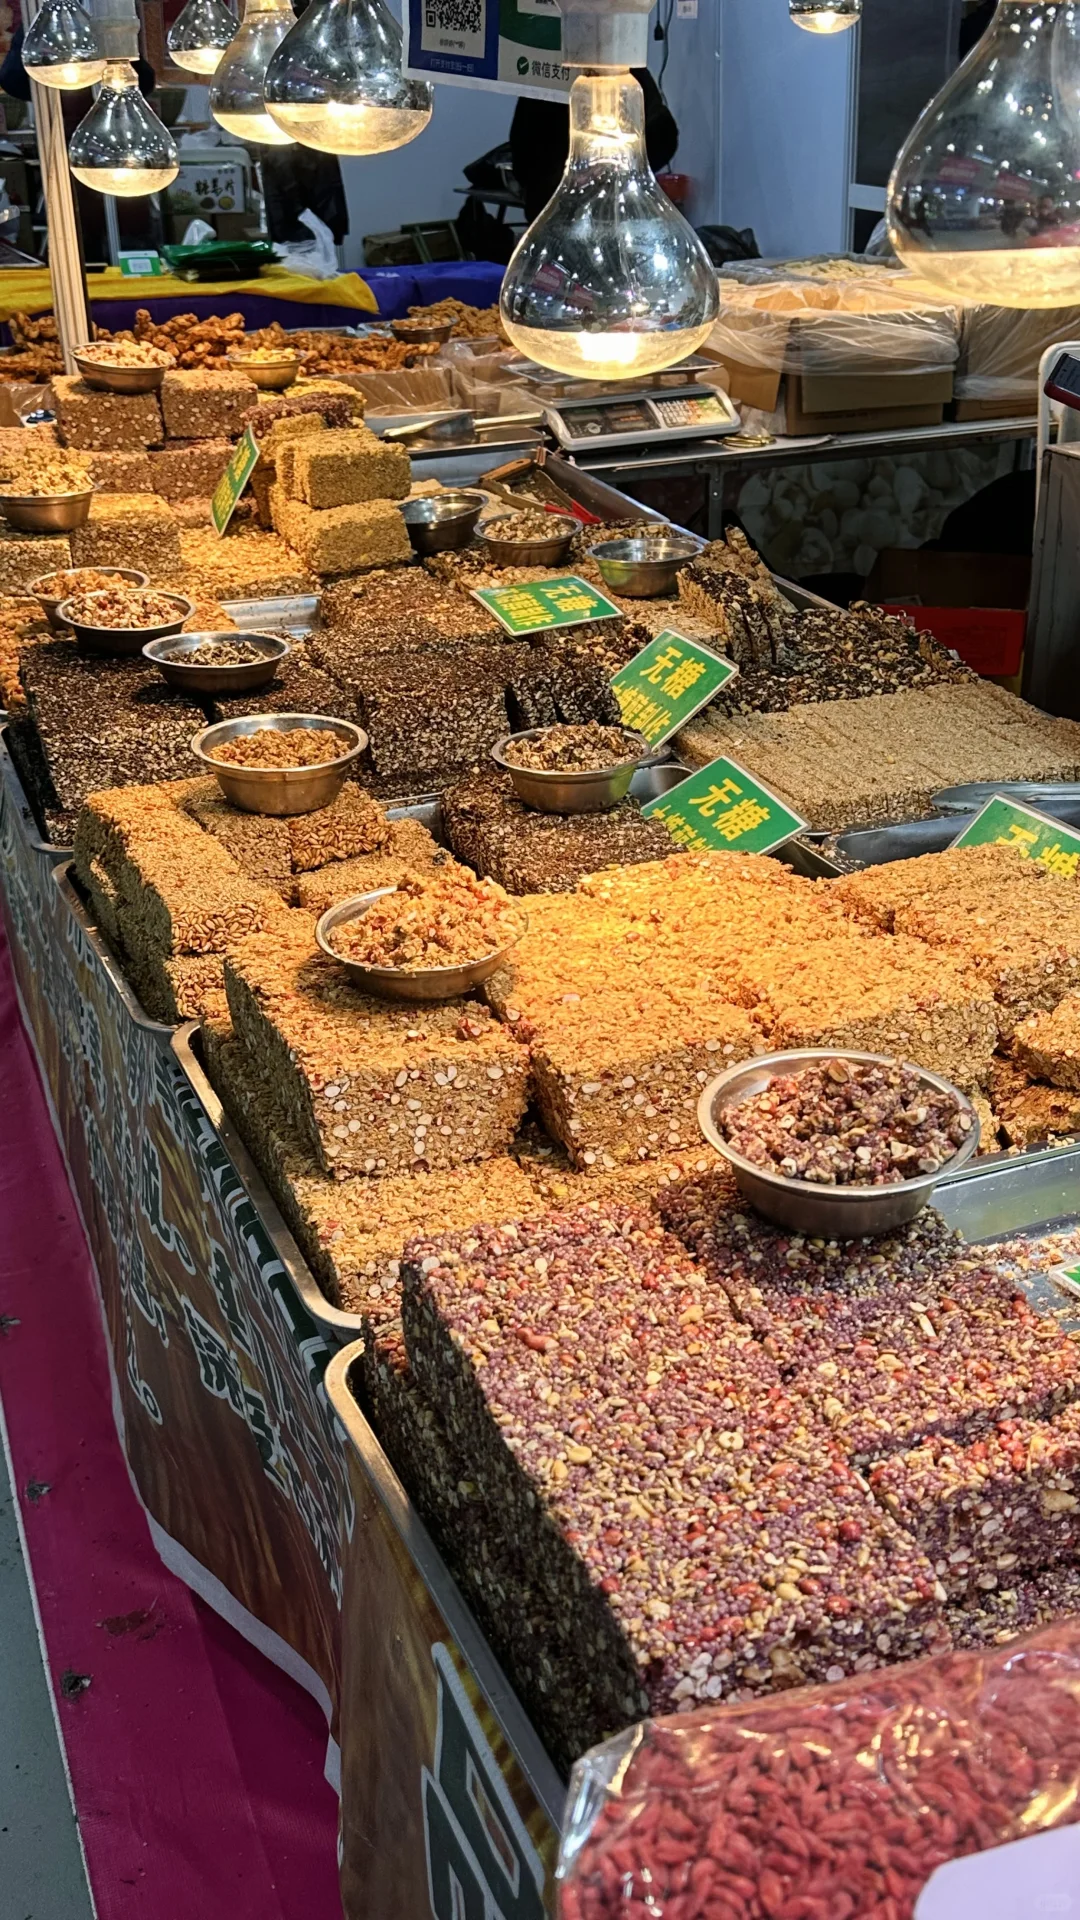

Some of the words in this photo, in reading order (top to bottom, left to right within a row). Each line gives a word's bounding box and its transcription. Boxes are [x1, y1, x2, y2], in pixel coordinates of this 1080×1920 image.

[532, 60, 571, 81] 微信支付
[540, 584, 599, 613] 无糖
[640, 646, 707, 700] 无糖
[688, 778, 771, 842] 无糖
